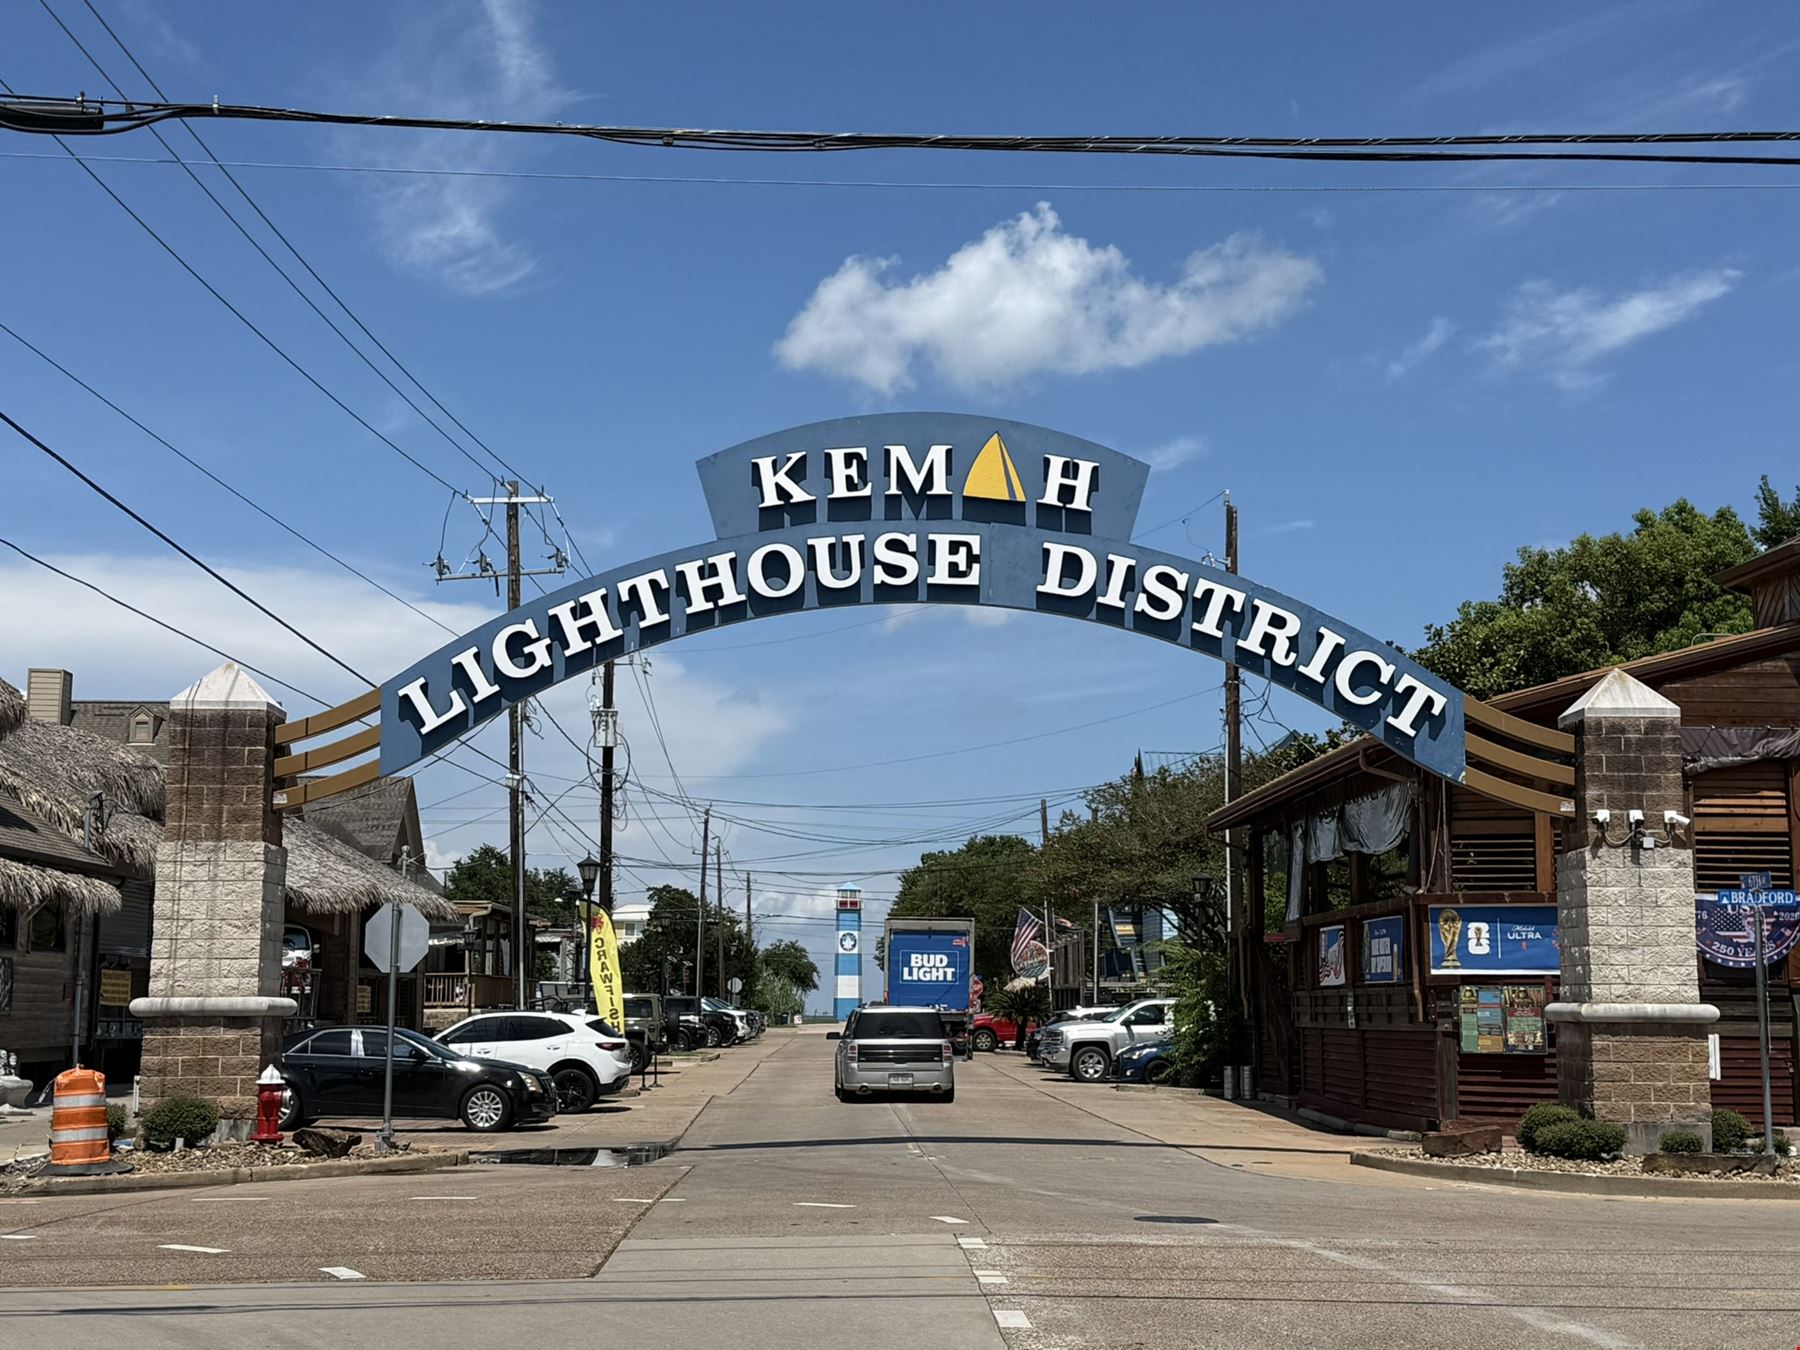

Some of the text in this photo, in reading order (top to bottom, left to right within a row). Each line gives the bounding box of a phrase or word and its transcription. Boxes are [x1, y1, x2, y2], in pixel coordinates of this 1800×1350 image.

[398, 532, 1447, 738] LIGHTHOUSE DISTRICT
[1731, 891, 1793, 904] BRADFORD
[1507, 931, 1542, 940] ULTRA
[1711, 941, 1734, 955] 250
[910, 953, 948, 968] BUD
[902, 967, 956, 982] LIGHT
